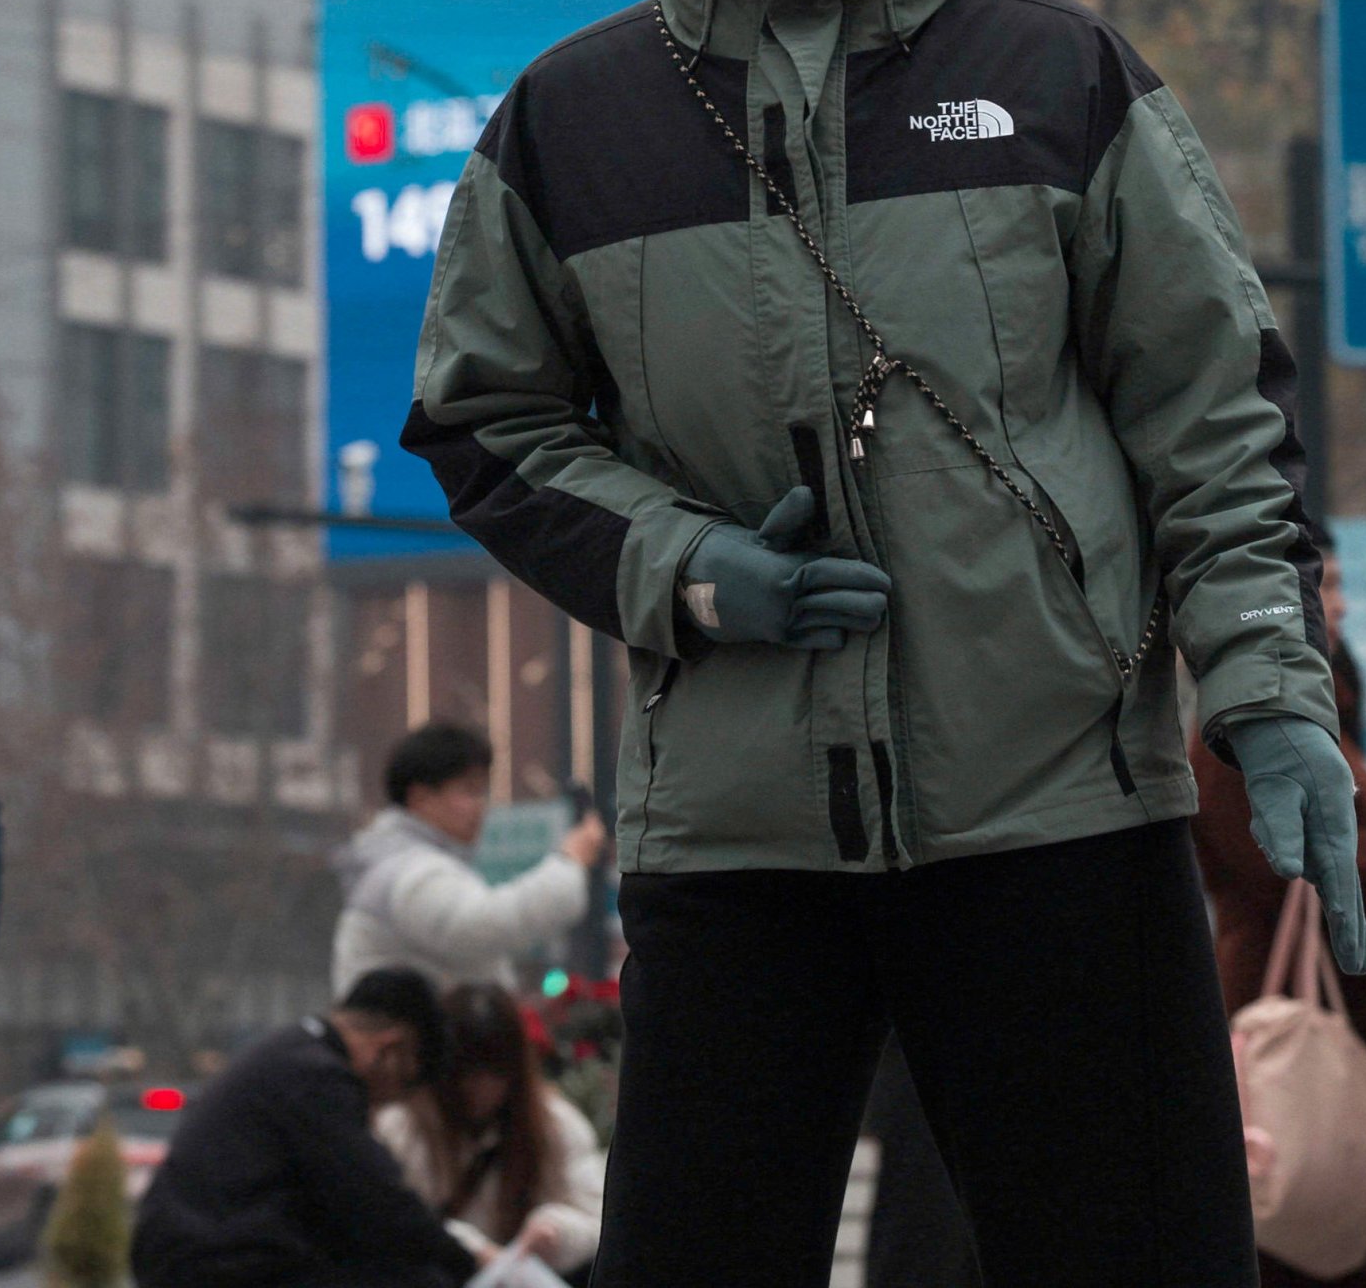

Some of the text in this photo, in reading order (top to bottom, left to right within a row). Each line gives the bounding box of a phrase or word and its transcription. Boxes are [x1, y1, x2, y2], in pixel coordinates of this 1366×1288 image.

[937, 101, 976, 114] THE
[910, 113, 976, 130] NORTH
[930, 126, 978, 142] FACE
[1240, 605, 1295, 621] DRYVENT
